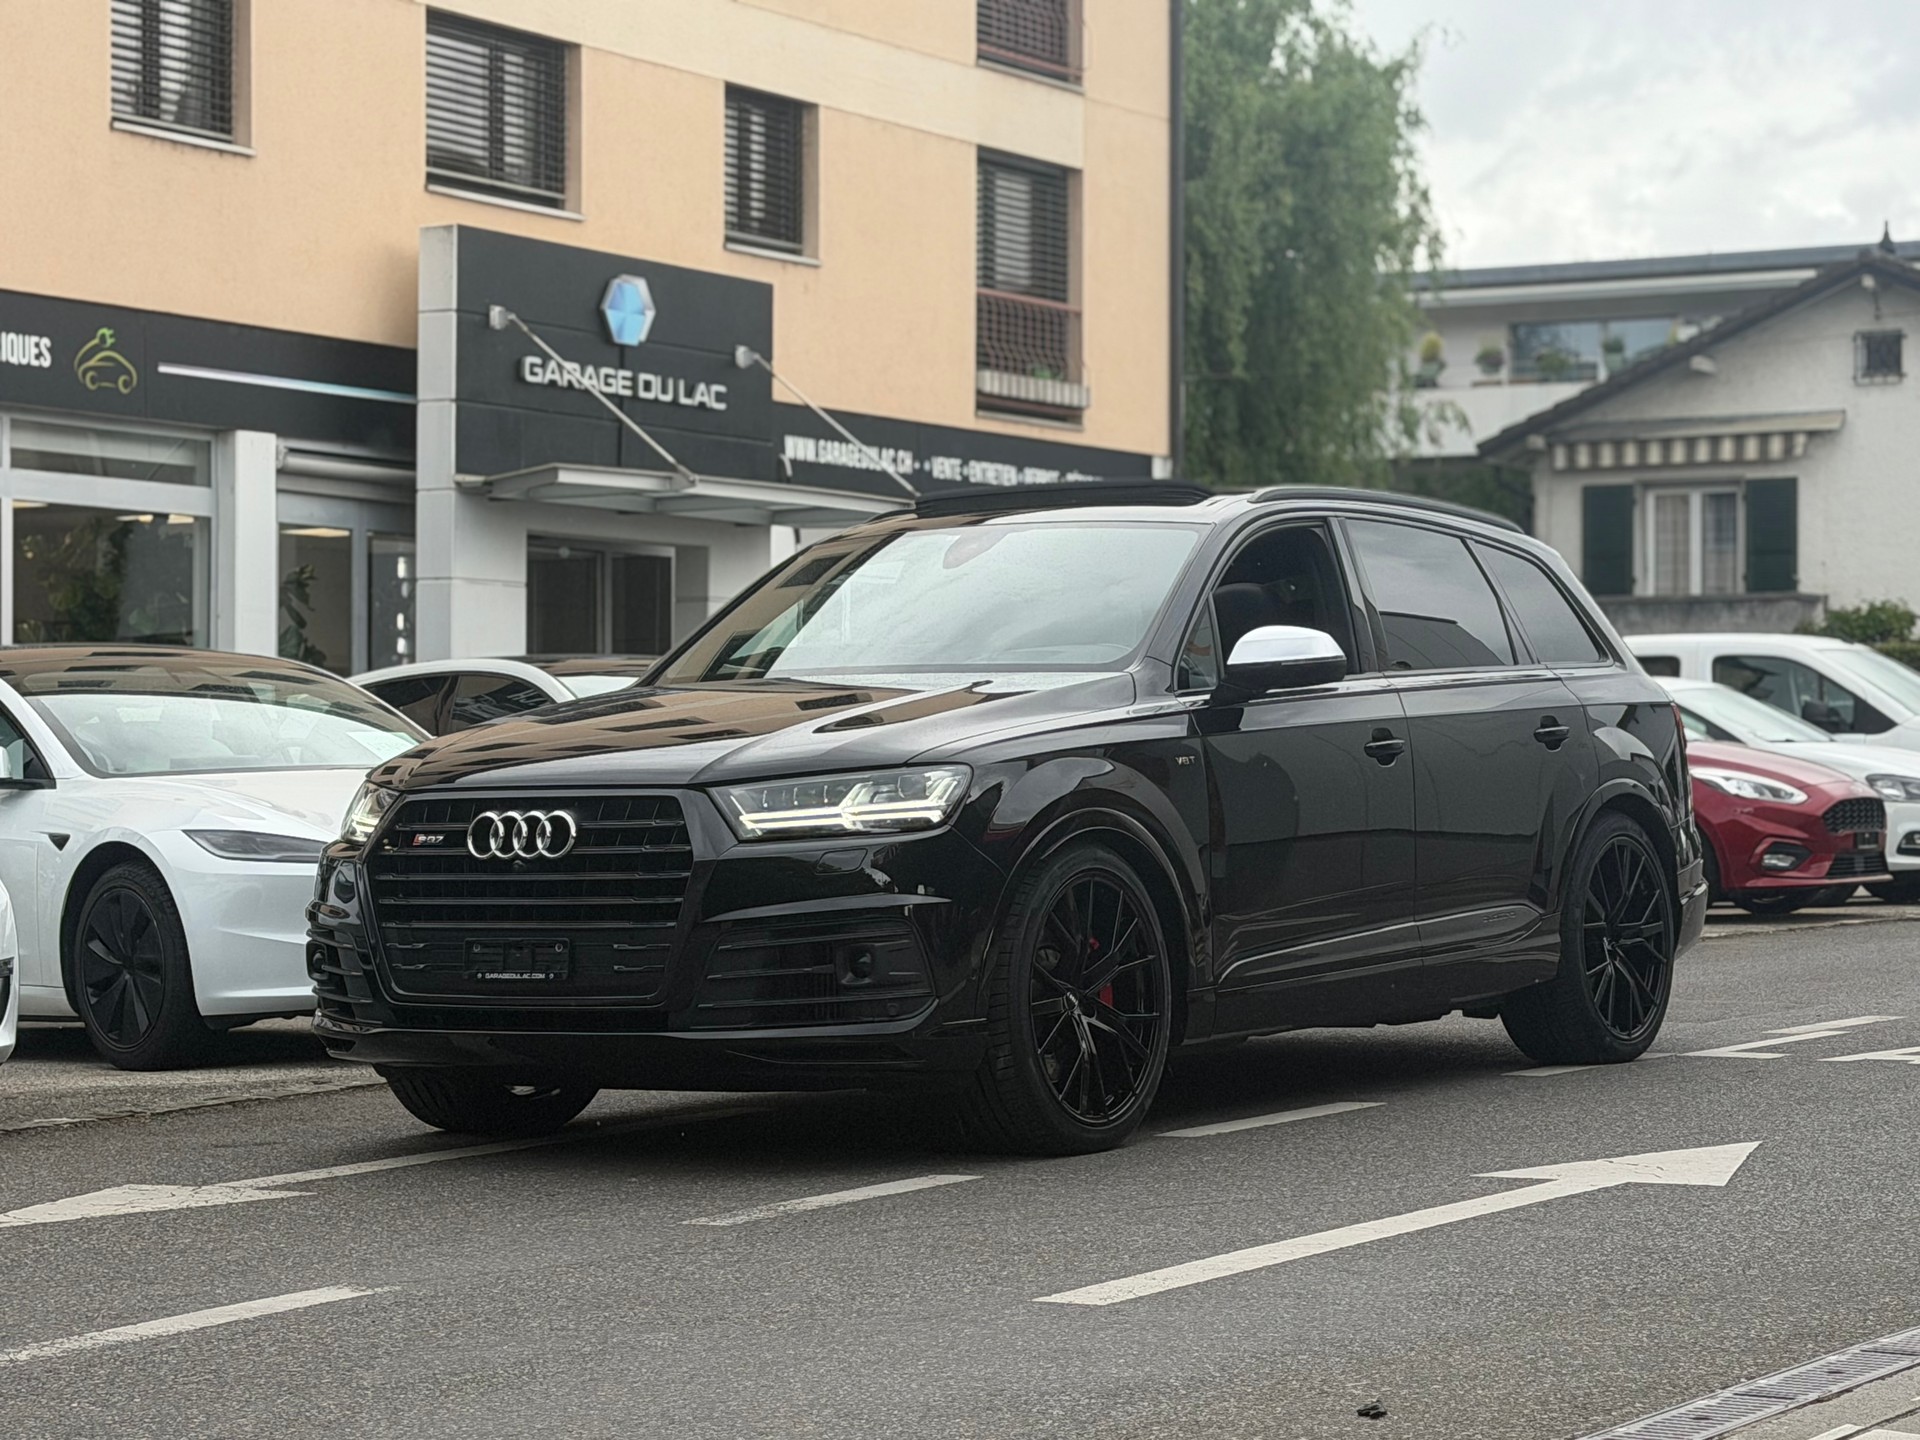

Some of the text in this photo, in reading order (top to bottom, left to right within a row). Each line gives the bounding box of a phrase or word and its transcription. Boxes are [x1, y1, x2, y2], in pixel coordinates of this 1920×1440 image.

[0, 331, 52, 369] IQUES
[524, 356, 727, 410] GARAGE DU LAC
